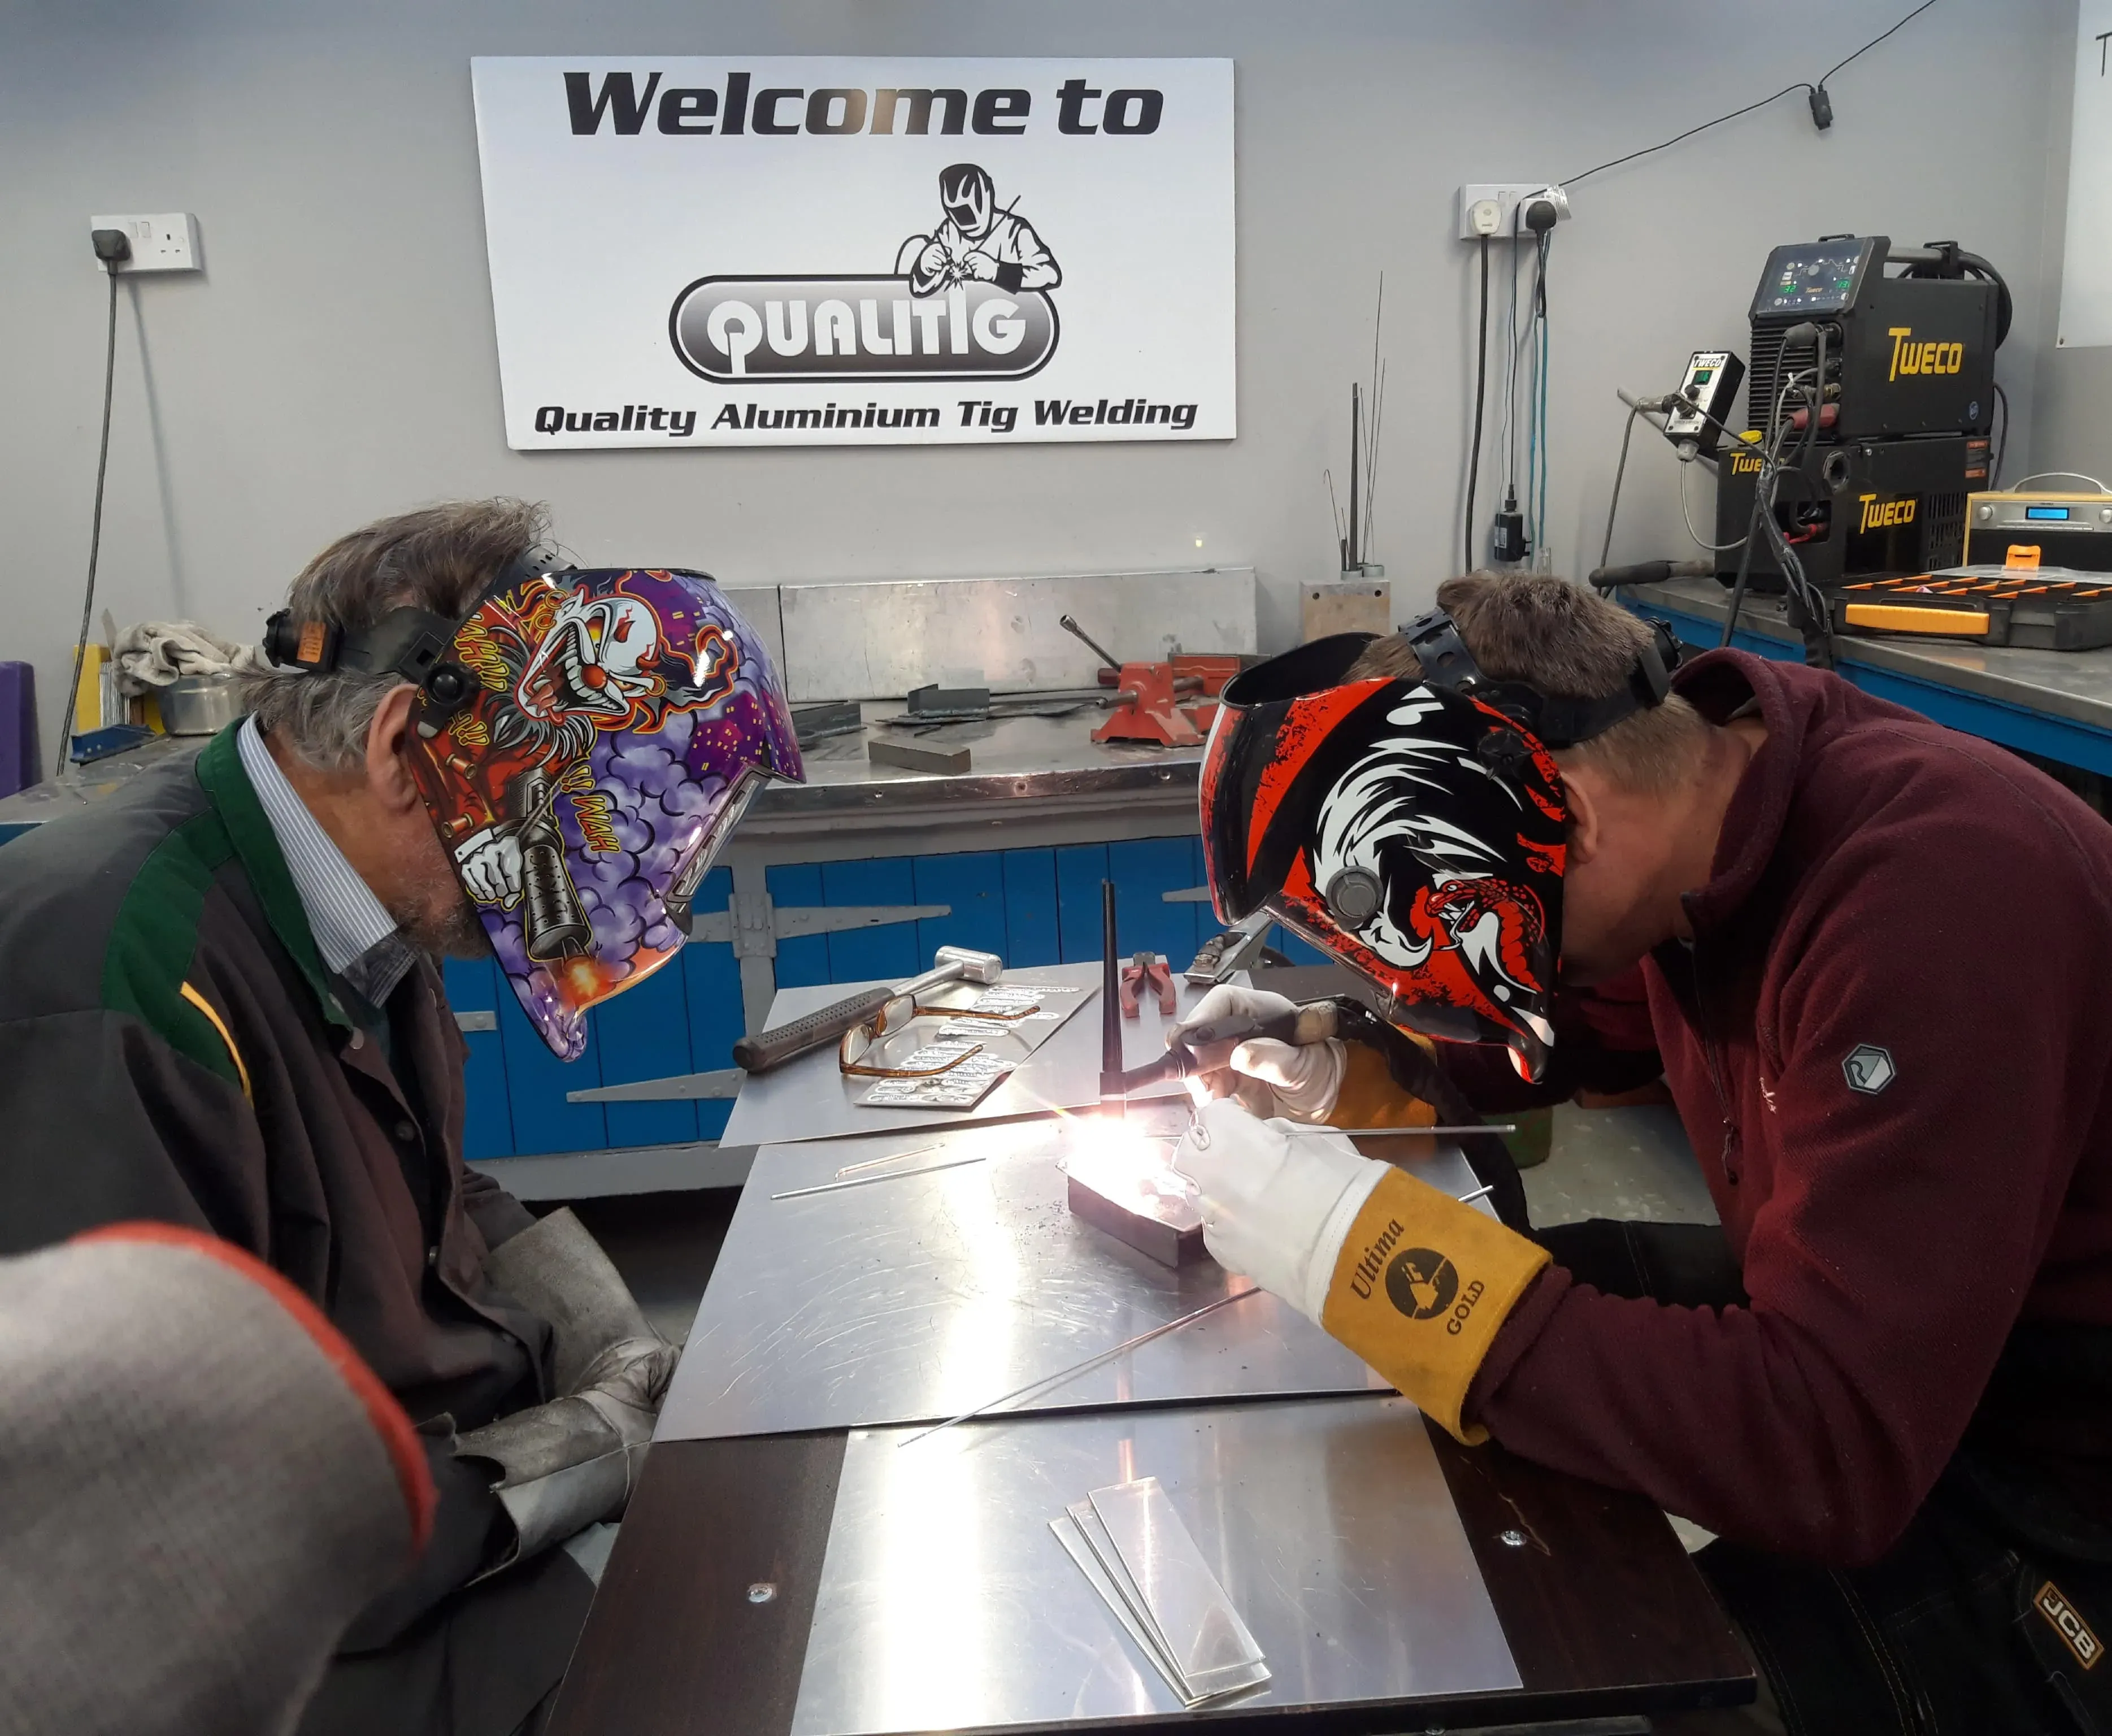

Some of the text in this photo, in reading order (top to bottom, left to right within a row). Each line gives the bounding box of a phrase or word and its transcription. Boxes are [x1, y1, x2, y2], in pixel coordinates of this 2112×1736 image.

[563, 71, 1164, 136] Welcome to
[707, 287, 1027, 375] QUALITIG
[534, 398, 1198, 437] Quality Aluminium Tig Welding
[1350, 1218, 1405, 1300] Ultima
[1446, 1279, 1485, 1336] GOLD
[2043, 1595, 2096, 1660] JCB
